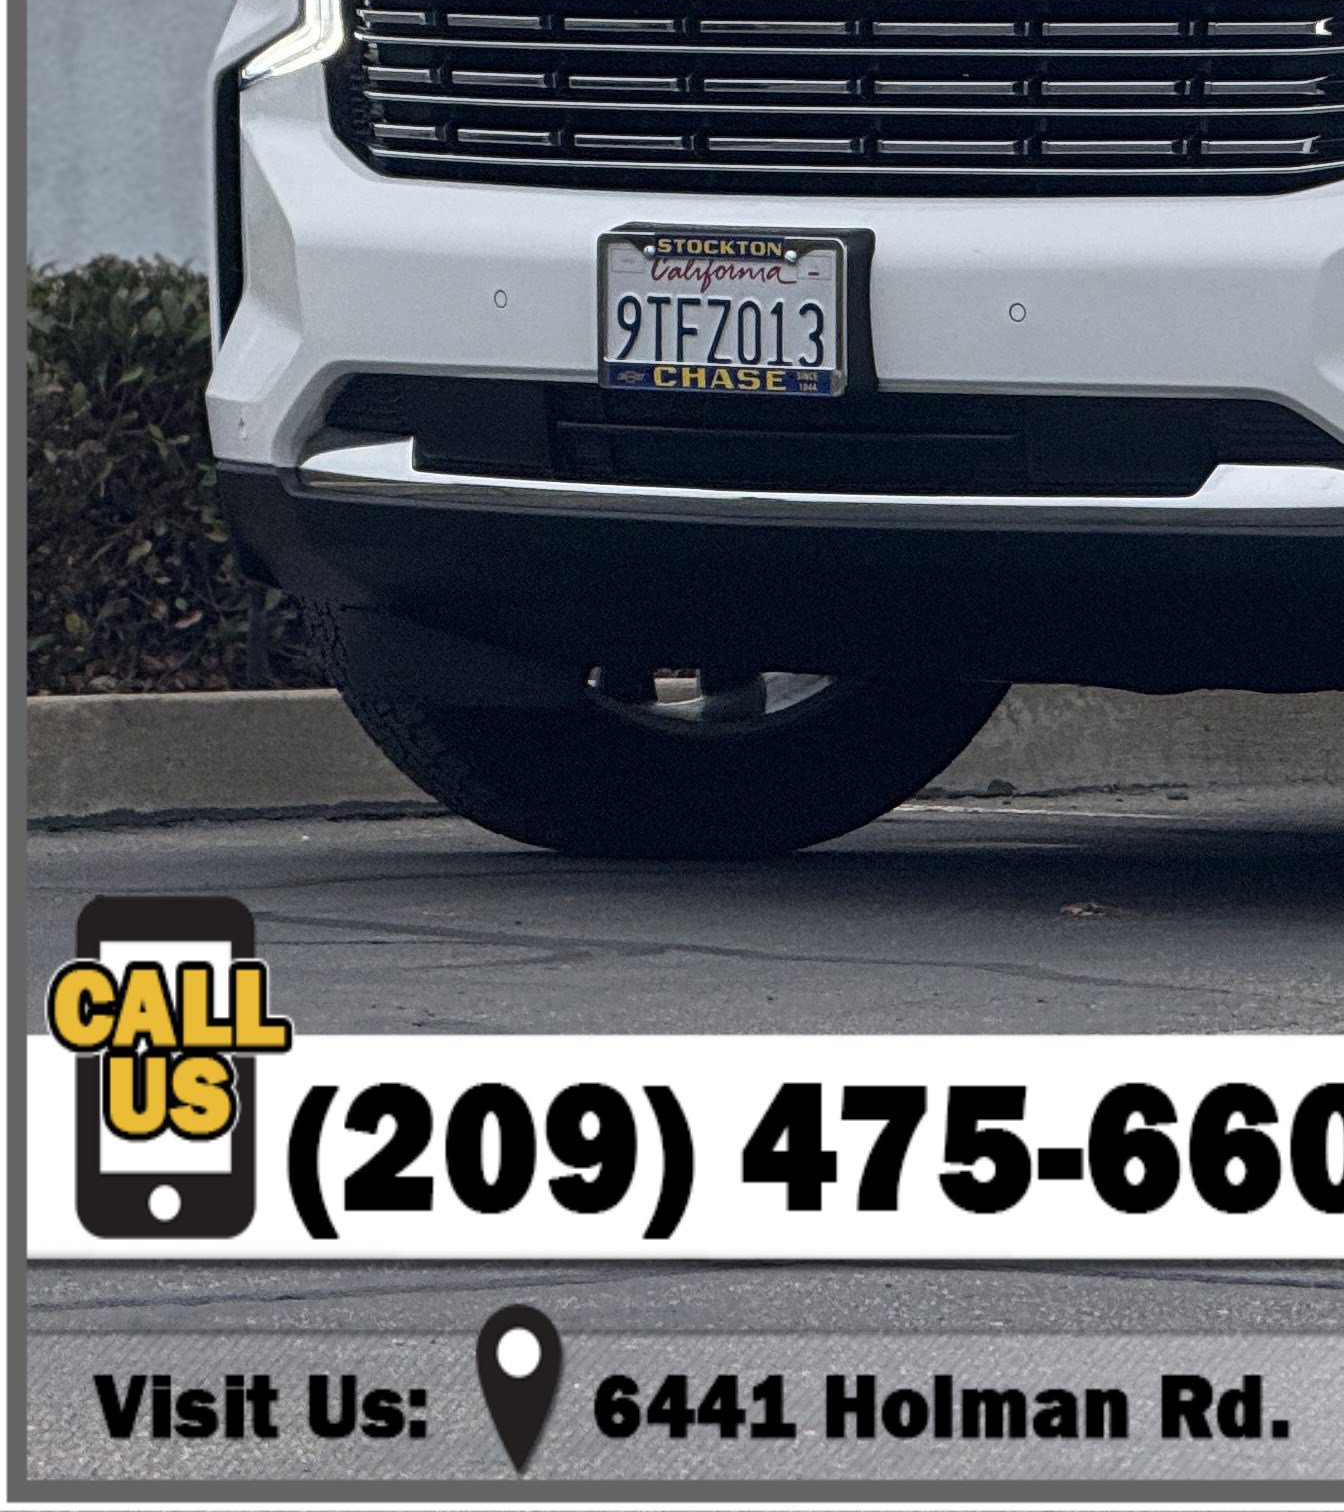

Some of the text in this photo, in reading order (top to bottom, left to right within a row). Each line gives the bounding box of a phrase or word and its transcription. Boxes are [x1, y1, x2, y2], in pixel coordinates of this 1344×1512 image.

[657, 238, 783, 257] STOCKTON
[650, 258, 797, 293] California
[616, 295, 825, 368] 9TFZ013
[653, 366, 787, 392] CHASE
